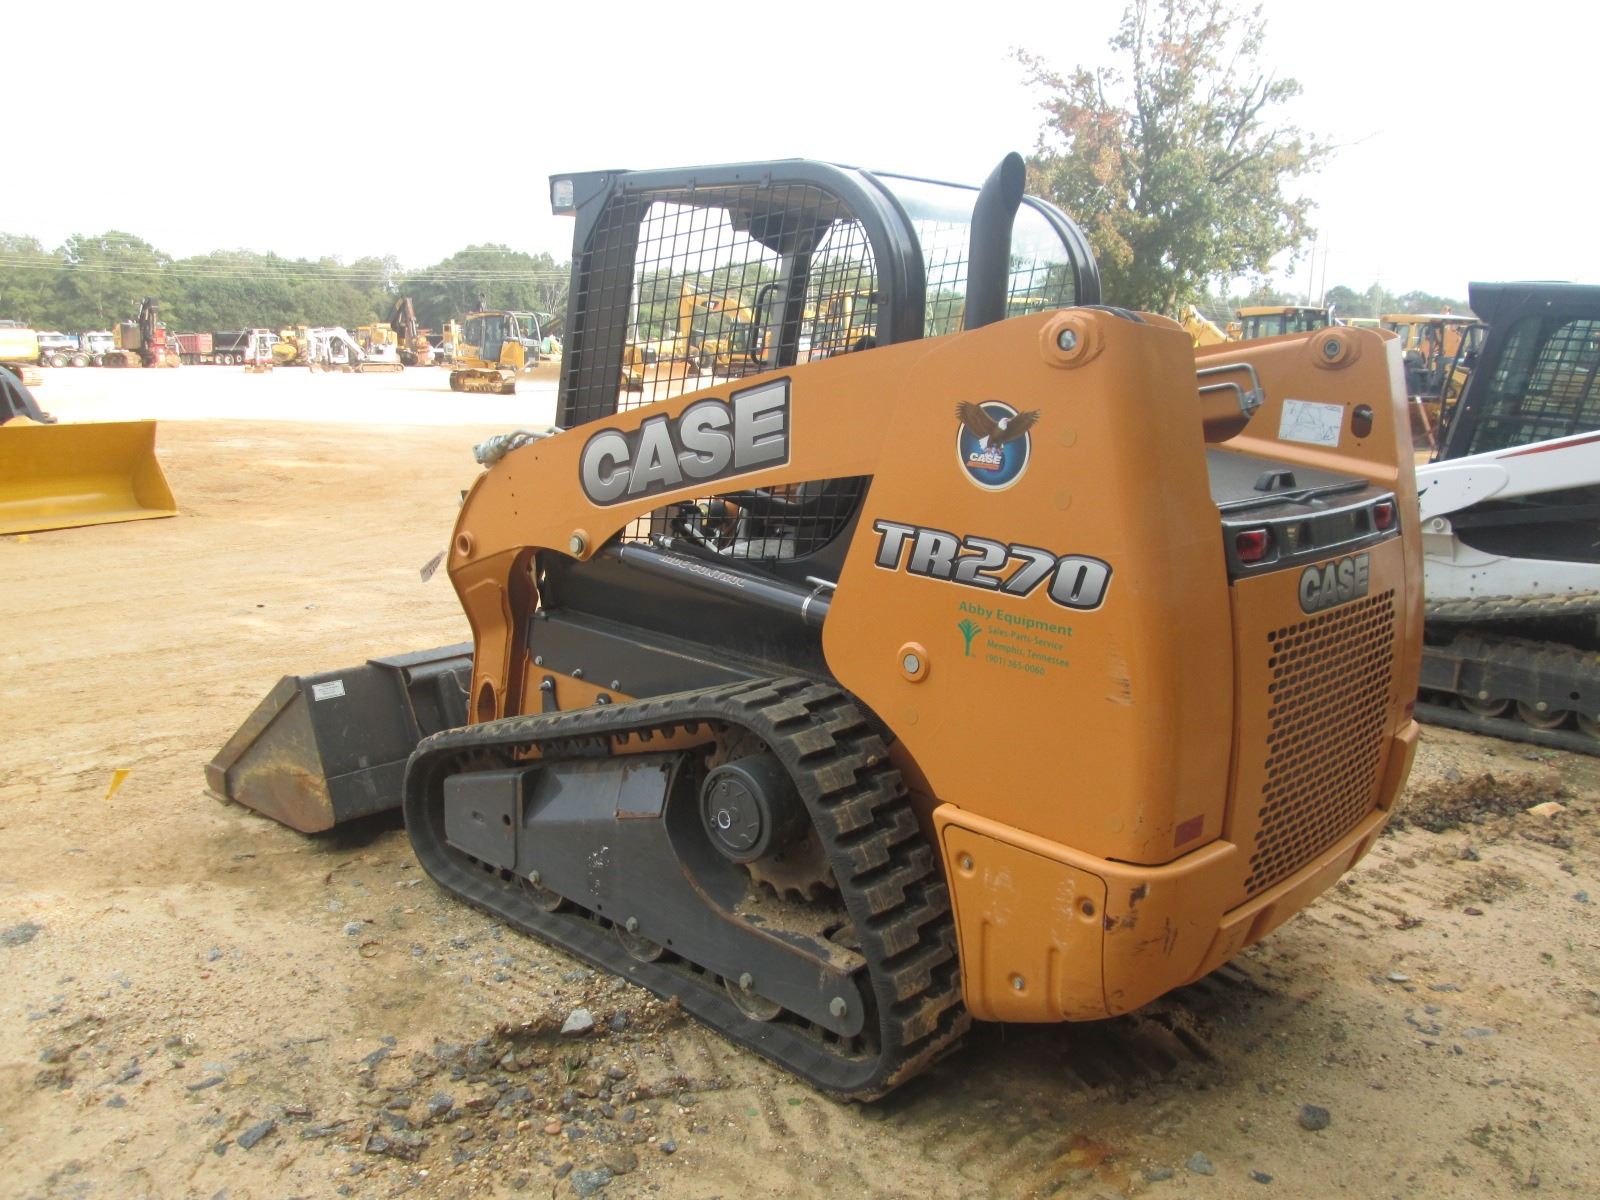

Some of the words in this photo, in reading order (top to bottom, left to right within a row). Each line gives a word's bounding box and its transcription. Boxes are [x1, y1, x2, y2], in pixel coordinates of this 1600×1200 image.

[580, 376, 791, 506] CASE
[969, 452, 1002, 464] CASE
[873, 519, 1113, 611] TR270
[1298, 553, 1370, 614] CASE
[959, 601, 992, 619] Abby
[996, 608, 1073, 637] Equipment
